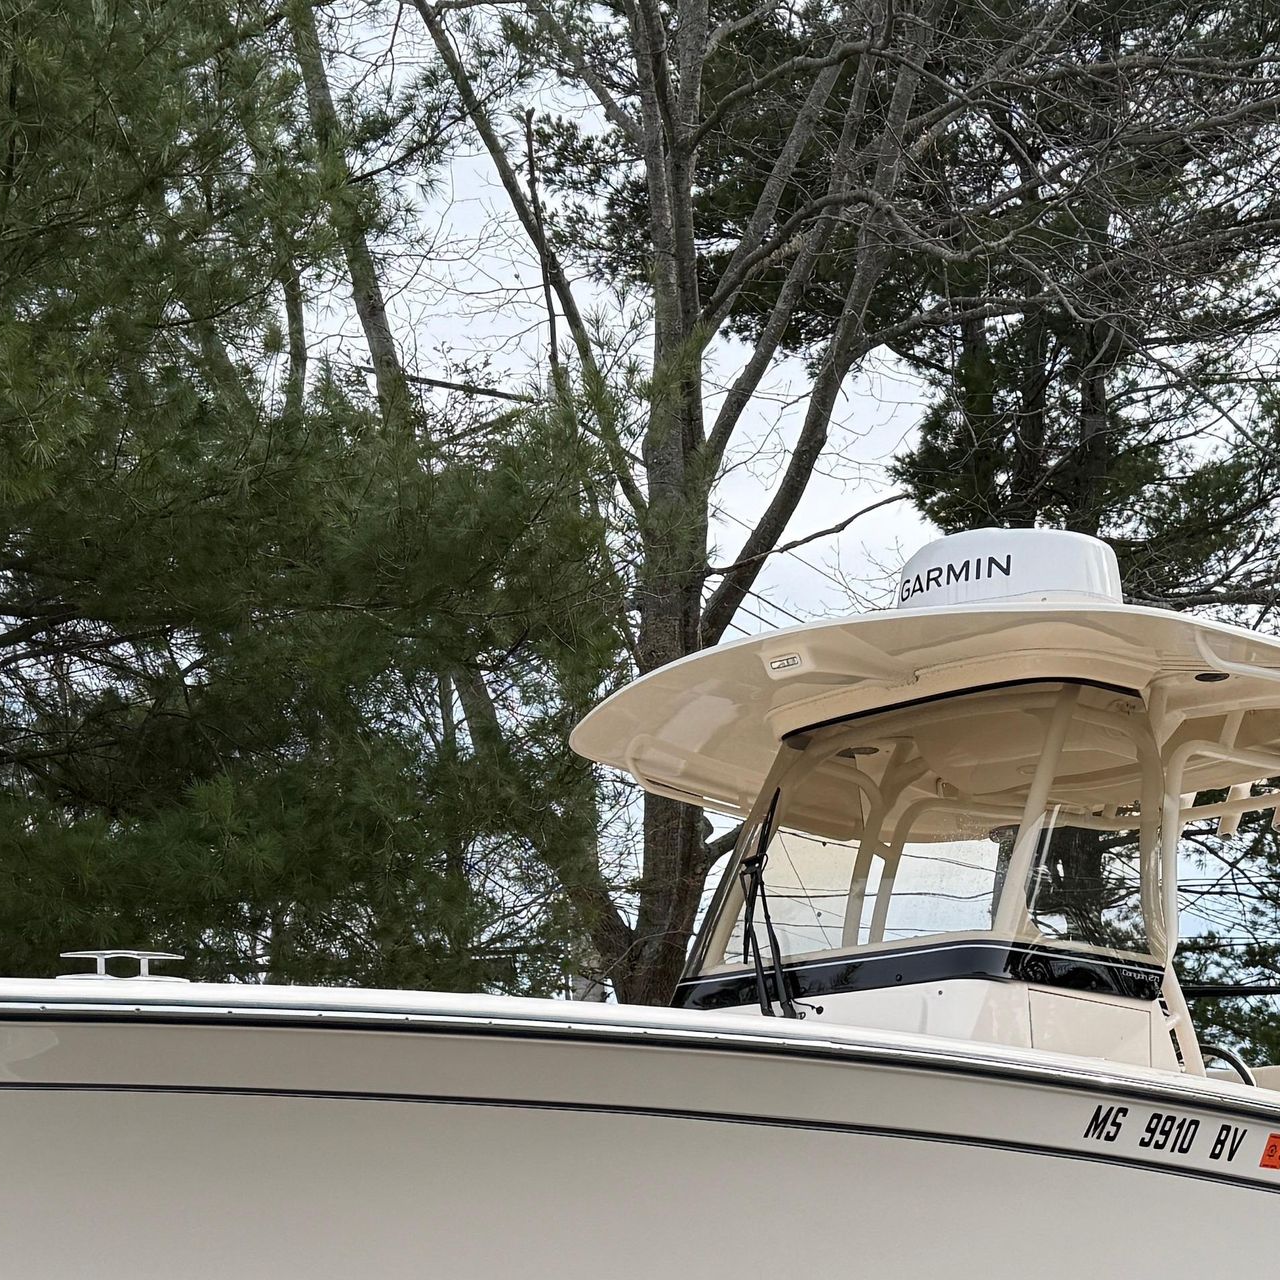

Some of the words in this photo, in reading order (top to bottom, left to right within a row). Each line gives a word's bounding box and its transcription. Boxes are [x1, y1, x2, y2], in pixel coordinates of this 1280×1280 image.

[900, 554, 1012, 602] GARMIN
[1083, 1104, 1129, 1142] MS
[1138, 1112, 1200, 1154] 9910
[1209, 1124, 1248, 1162] BV
